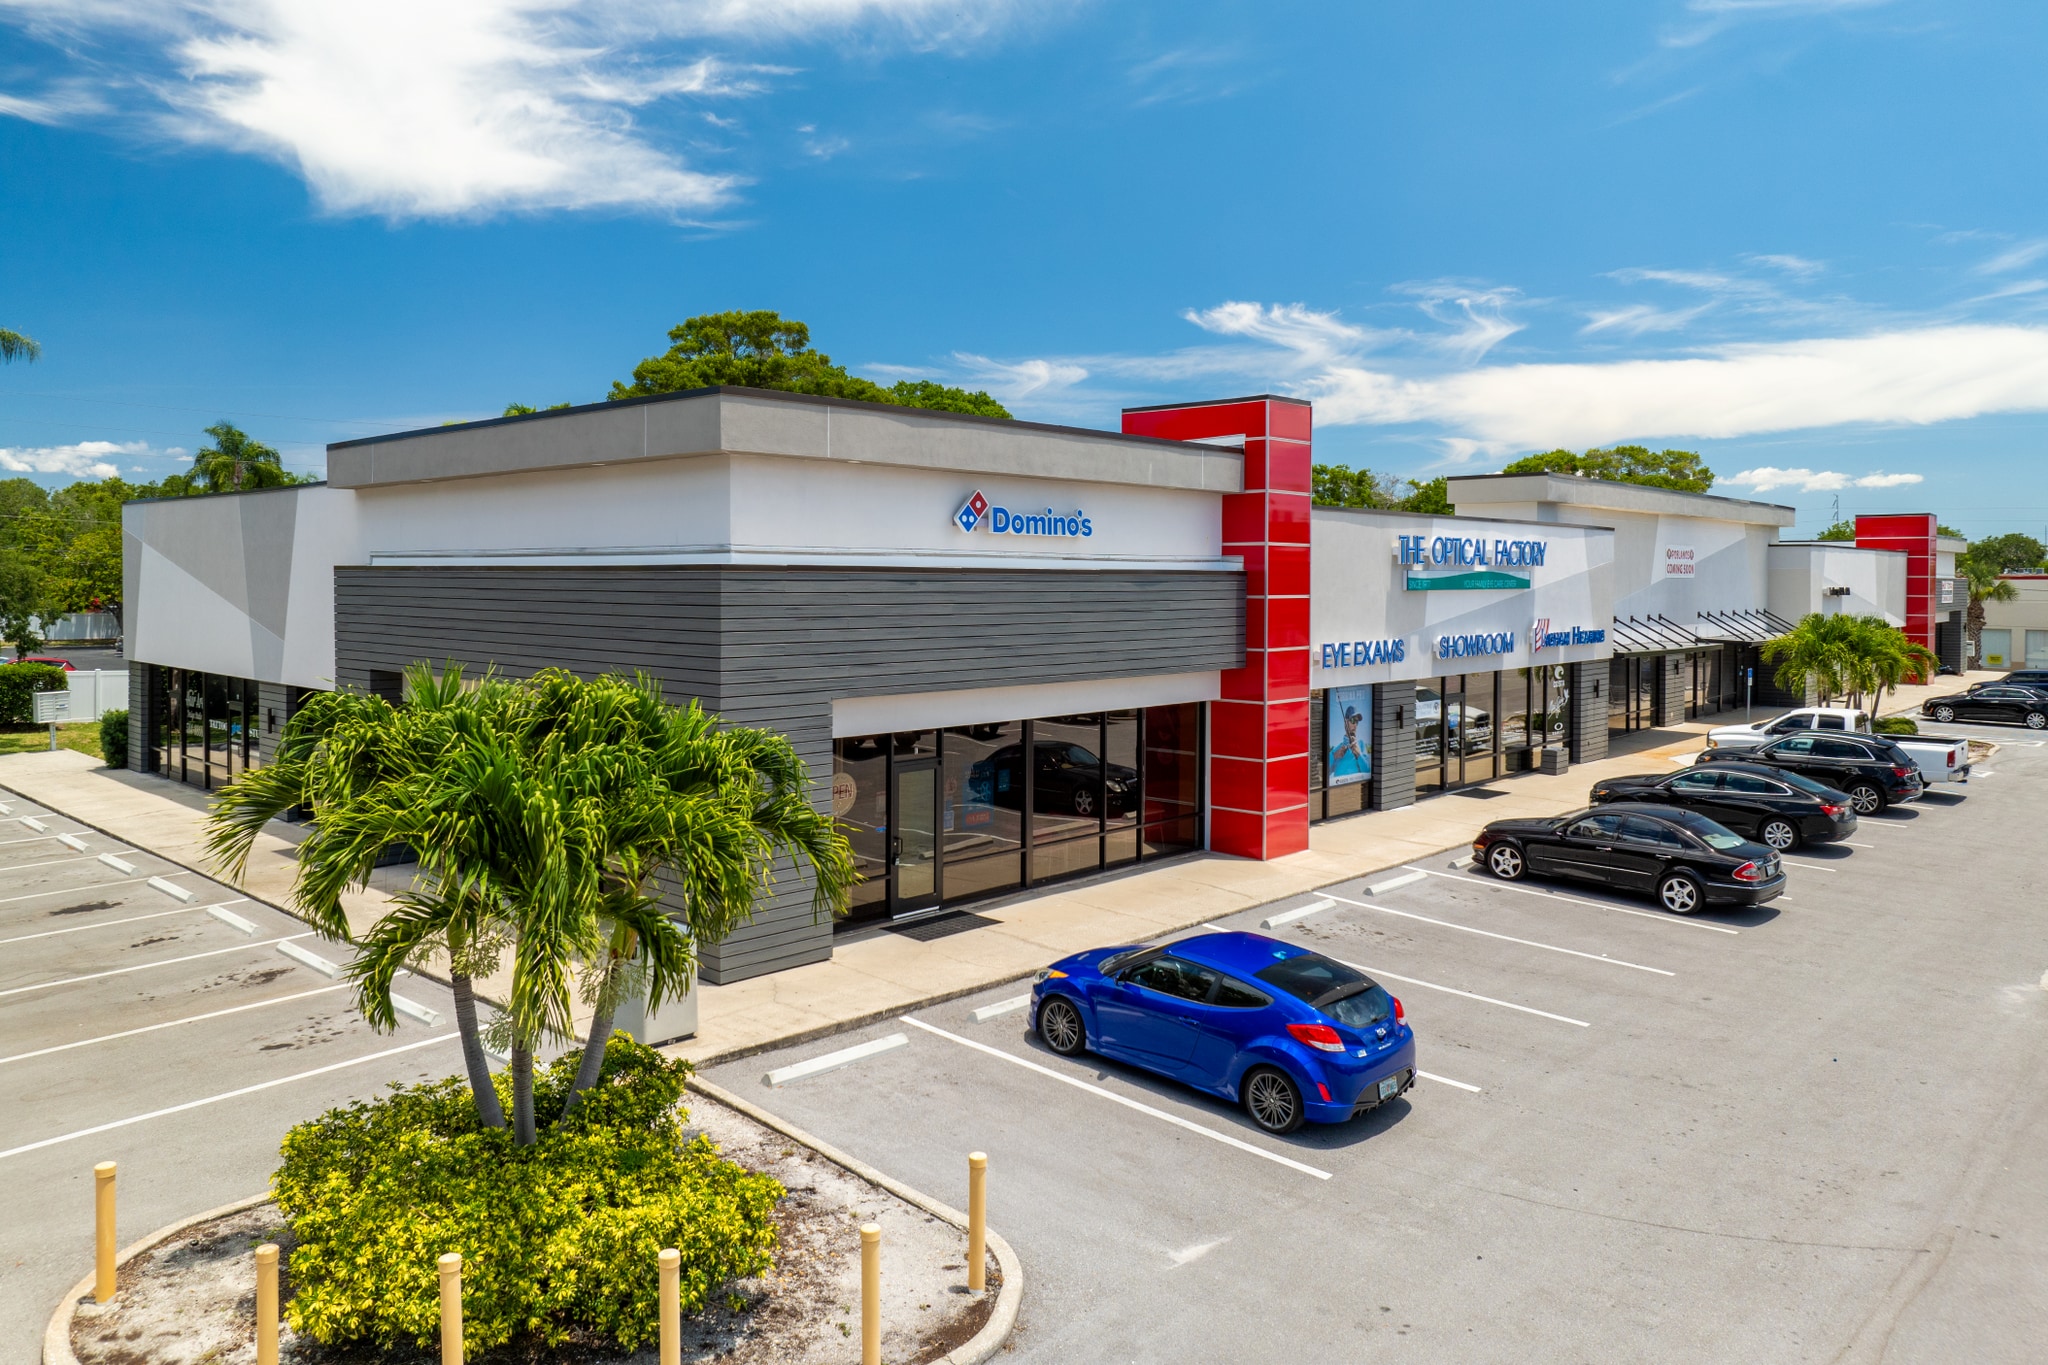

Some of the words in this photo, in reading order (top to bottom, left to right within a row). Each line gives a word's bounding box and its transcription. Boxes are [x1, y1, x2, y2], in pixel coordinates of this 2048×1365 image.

[991, 506, 1093, 537] Domino's
[1399, 535, 1425, 565] THE
[1431, 536, 1489, 566] OPTICAL
[1495, 539, 1548, 567] FACTORY
[1321, 642, 1350, 669] EYE
[1354, 639, 1405, 667] EXAMS
[1439, 632, 1514, 660] SHOWROOM
[832, 783, 853, 800] PEN
